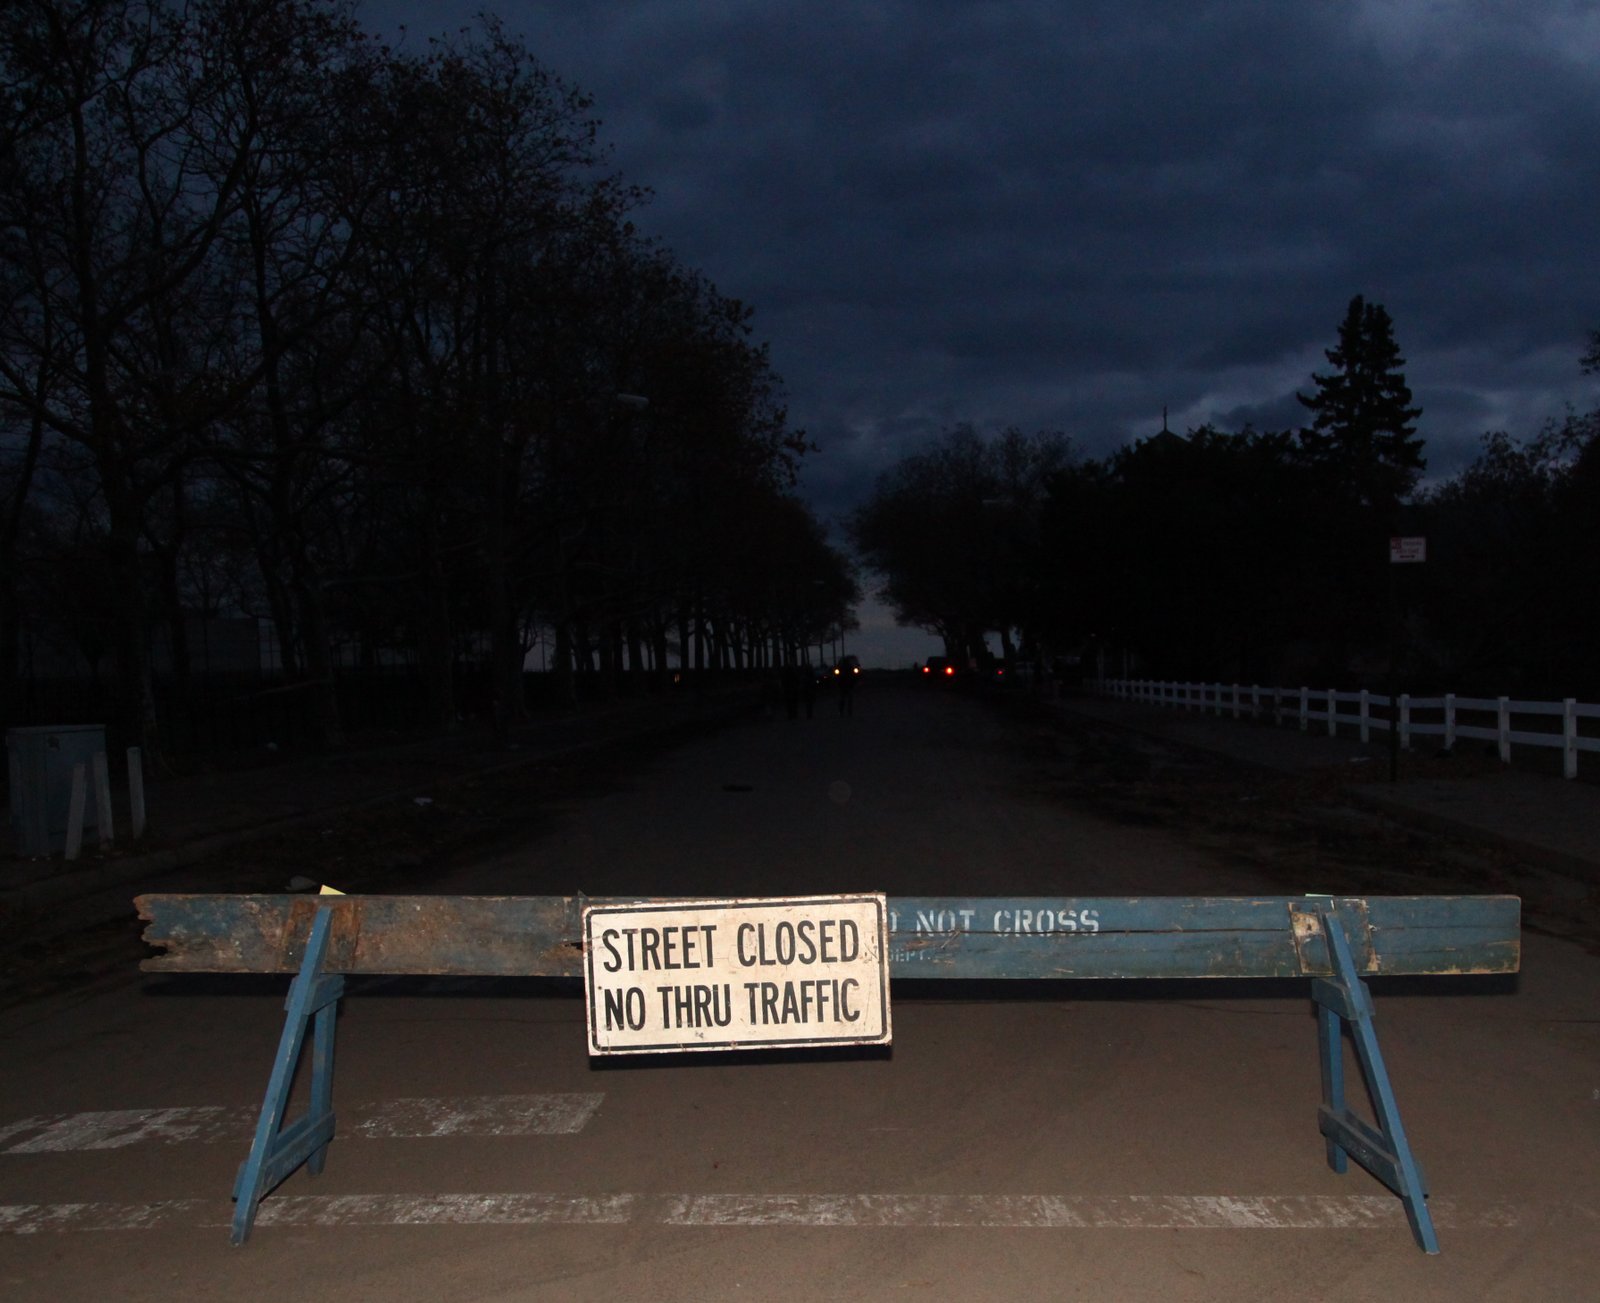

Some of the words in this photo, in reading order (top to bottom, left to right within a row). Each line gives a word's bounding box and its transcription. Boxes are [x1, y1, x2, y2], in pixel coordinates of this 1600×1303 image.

[602, 924, 717, 973] STREET
[737, 919, 859, 967] CLOSED
[916, 909, 975, 937] NOT
[994, 909, 1100, 937] CROSS
[605, 986, 646, 1031] NO
[657, 983, 731, 1029] THRU
[743, 977, 861, 1026] TRAFFIC
